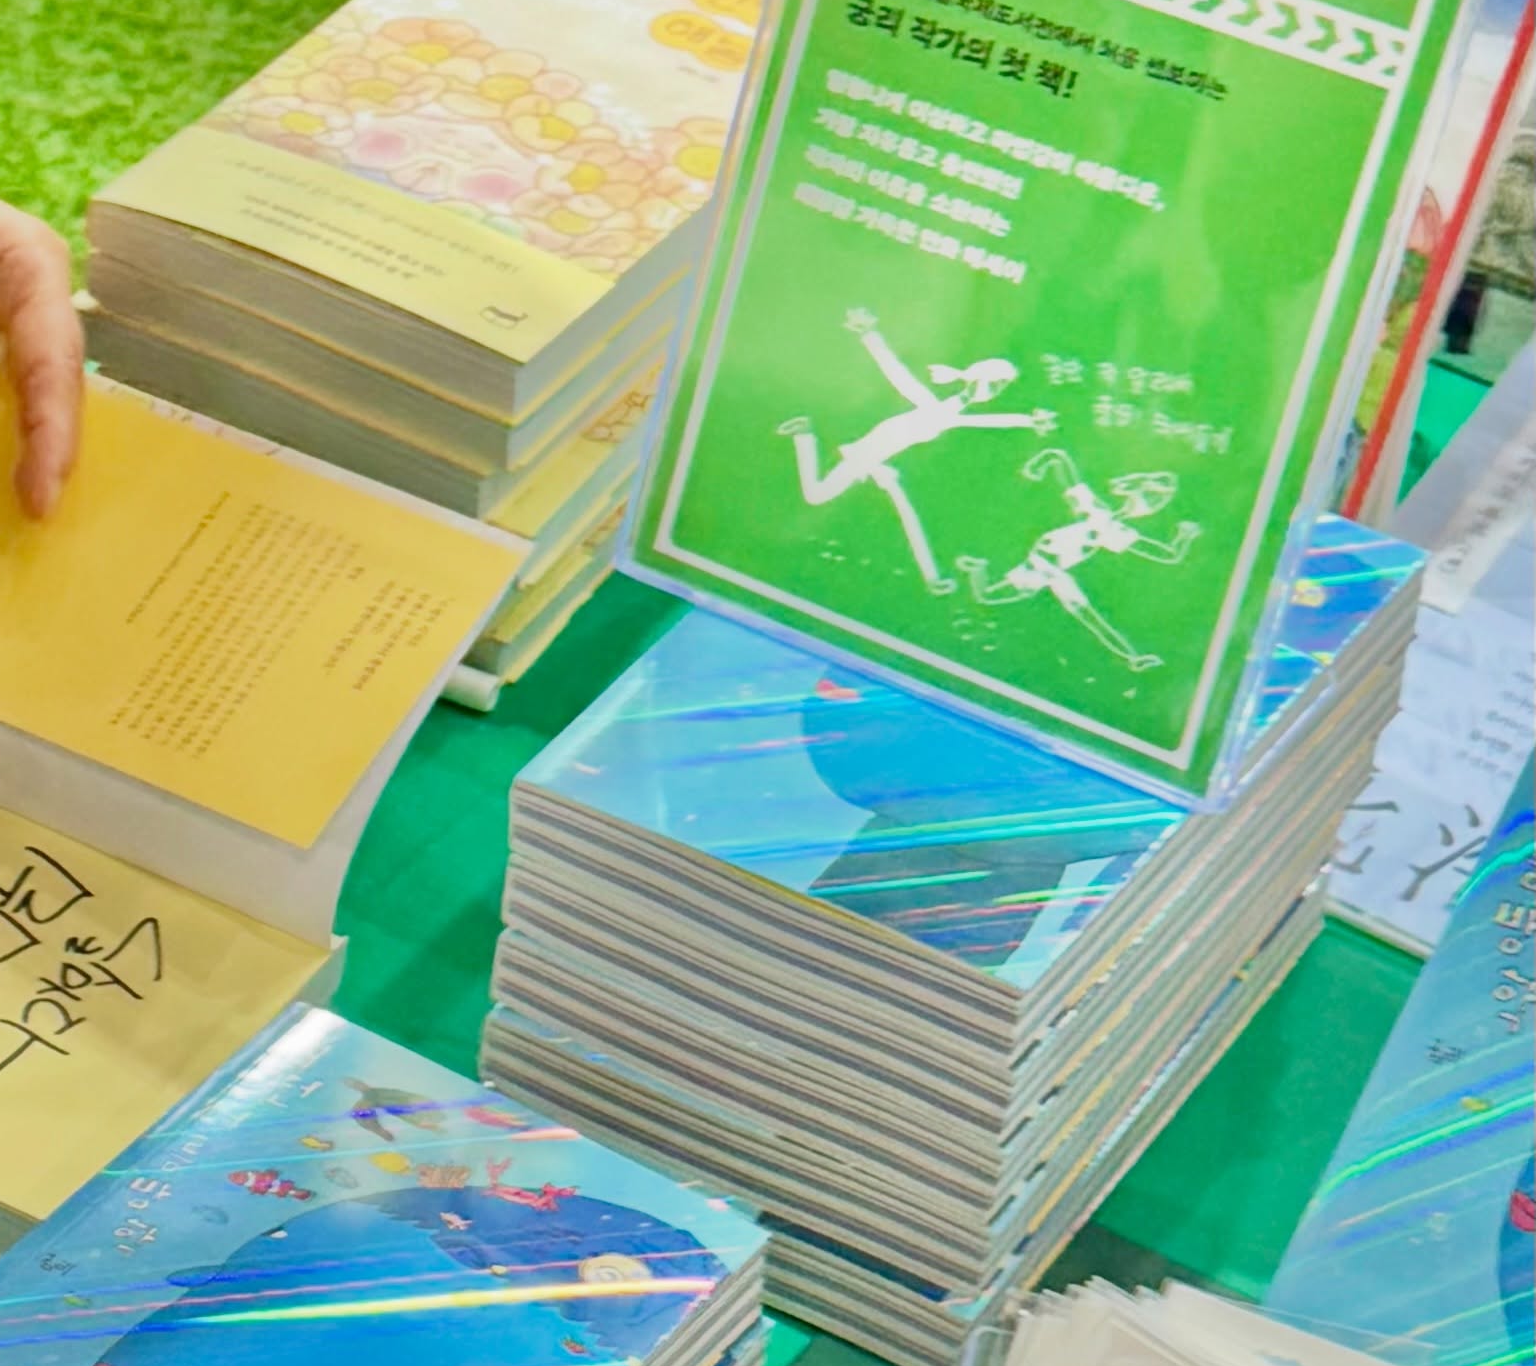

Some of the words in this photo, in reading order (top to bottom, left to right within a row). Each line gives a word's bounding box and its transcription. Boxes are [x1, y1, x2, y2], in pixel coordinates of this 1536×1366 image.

[906, 15, 996, 69] 작가의
[998, 45, 1030, 82] 첫
[1034, 60, 1080, 99] 책!
